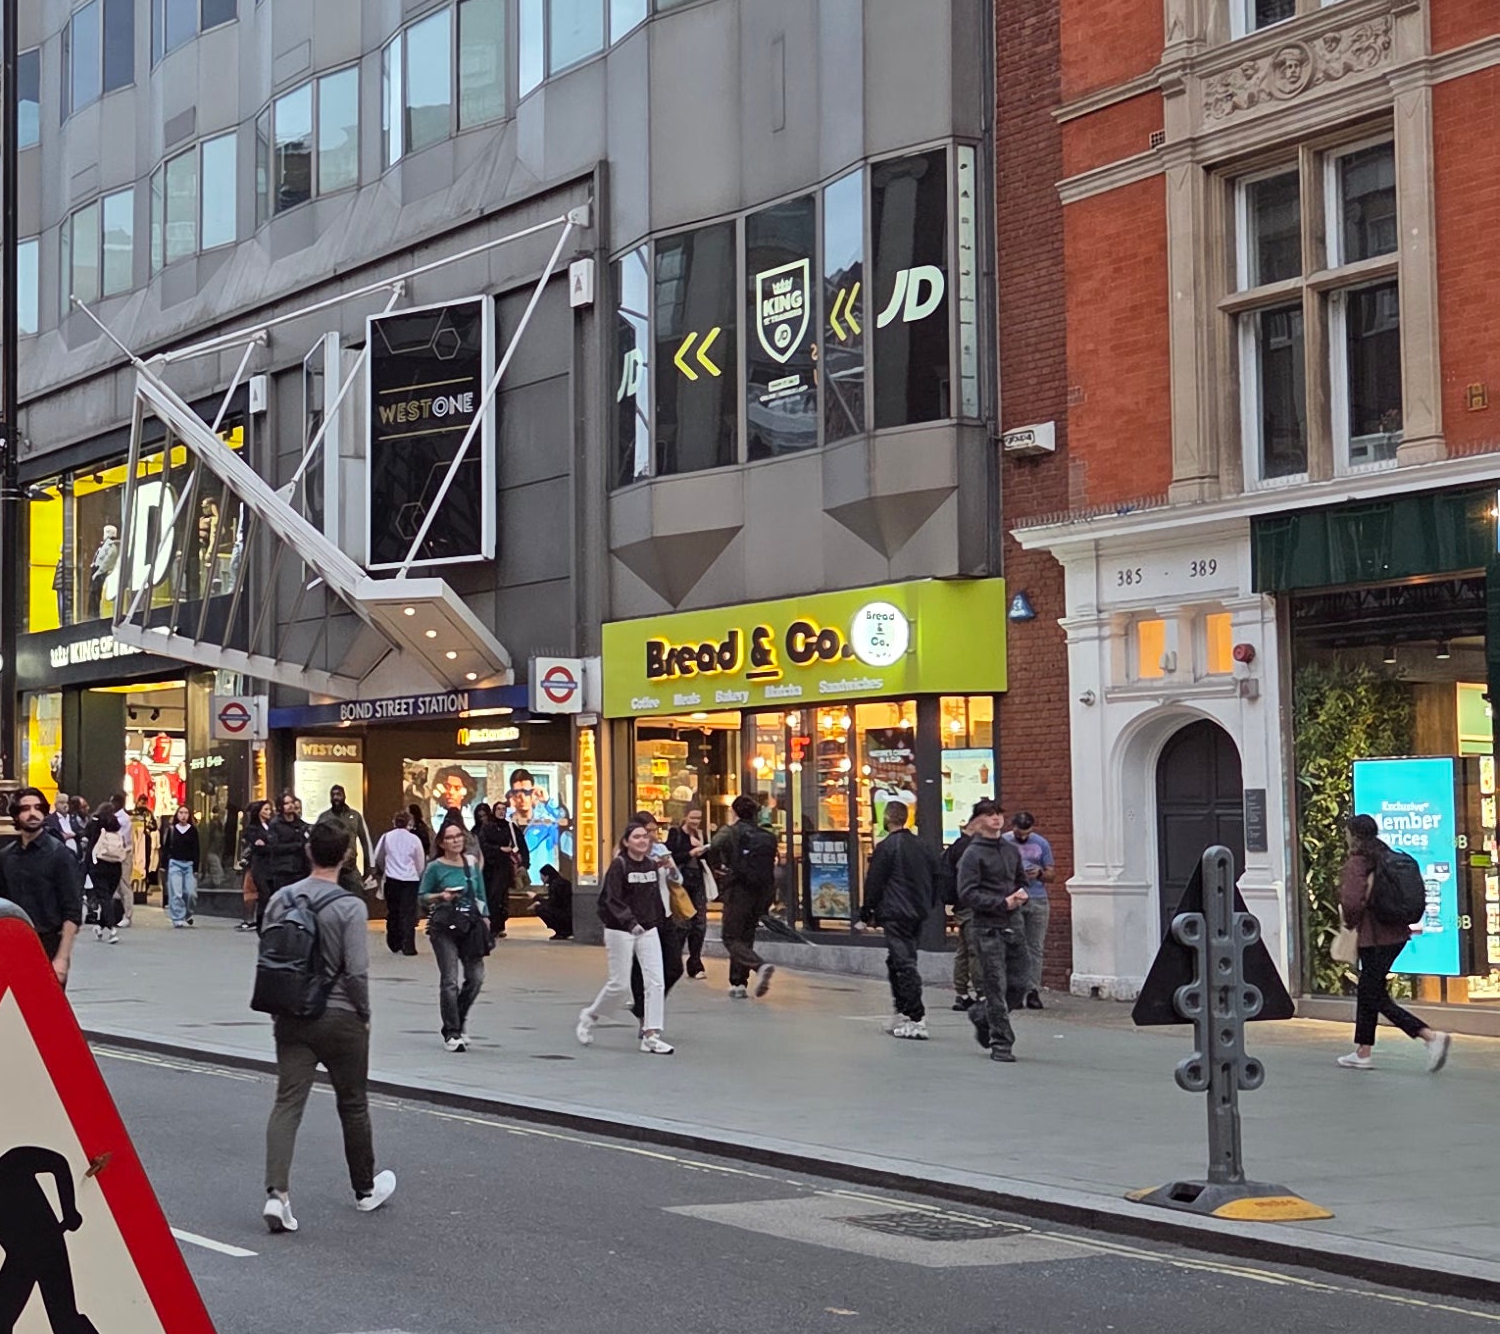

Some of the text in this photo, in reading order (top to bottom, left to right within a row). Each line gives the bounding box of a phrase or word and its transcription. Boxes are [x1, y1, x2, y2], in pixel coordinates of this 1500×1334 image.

[763, 289, 803, 317] KING
[876, 265, 946, 329] JD
[1117, 568, 1142, 587] 385
[1189, 559, 1217, 578] 389
[866, 611, 894, 620] Bread
[70, 638, 100, 664] KING
[646, 630, 740, 678] Bread
[871, 636, 890, 647] Co.
[340, 692, 469, 720] BOND STREET STATION
[301, 742, 358, 756] WESTONE
